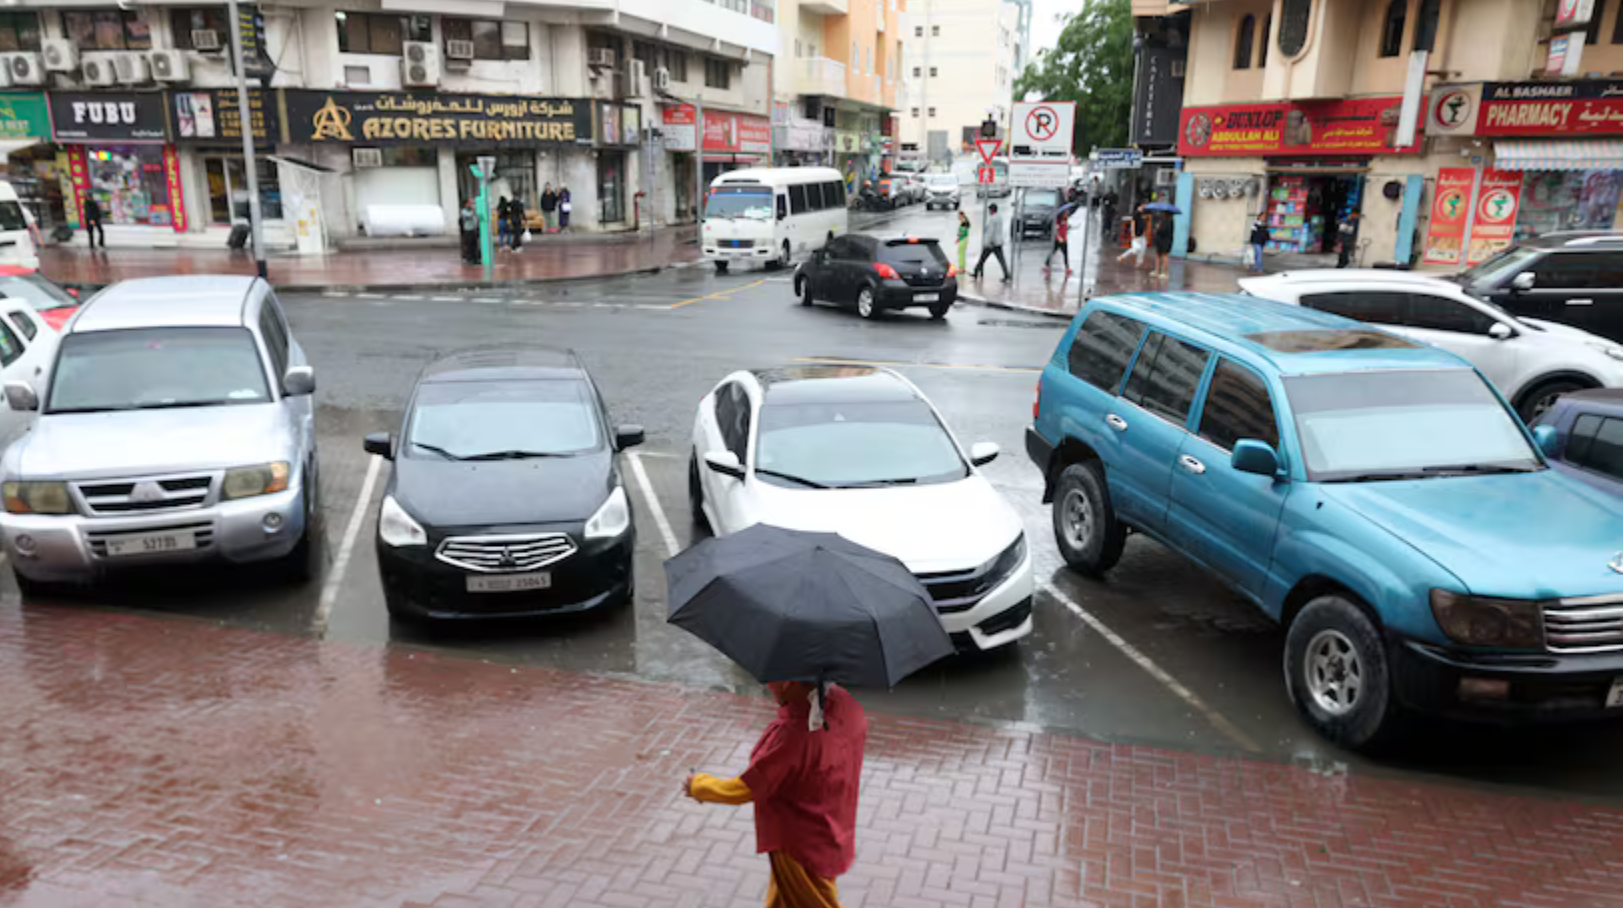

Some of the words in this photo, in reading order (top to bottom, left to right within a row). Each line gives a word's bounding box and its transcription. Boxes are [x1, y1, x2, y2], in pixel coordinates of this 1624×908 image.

[1495, 87, 1510, 97] AL
[1512, 86, 1573, 97] BASHAER
[72, 102, 136, 124] FUBU
[530, 101, 574, 117] شركة
[1226, 109, 1284, 129] DUNLOP
[1486, 102, 1573, 127] PHARMACY
[1579, 101, 1624, 127] يدلية
[363, 116, 457, 140] AZORES
[459, 118, 575, 140] FURNITURE
[1210, 131, 1260, 141] ABDULLAH
[1263, 130, 1280, 141] ALI
